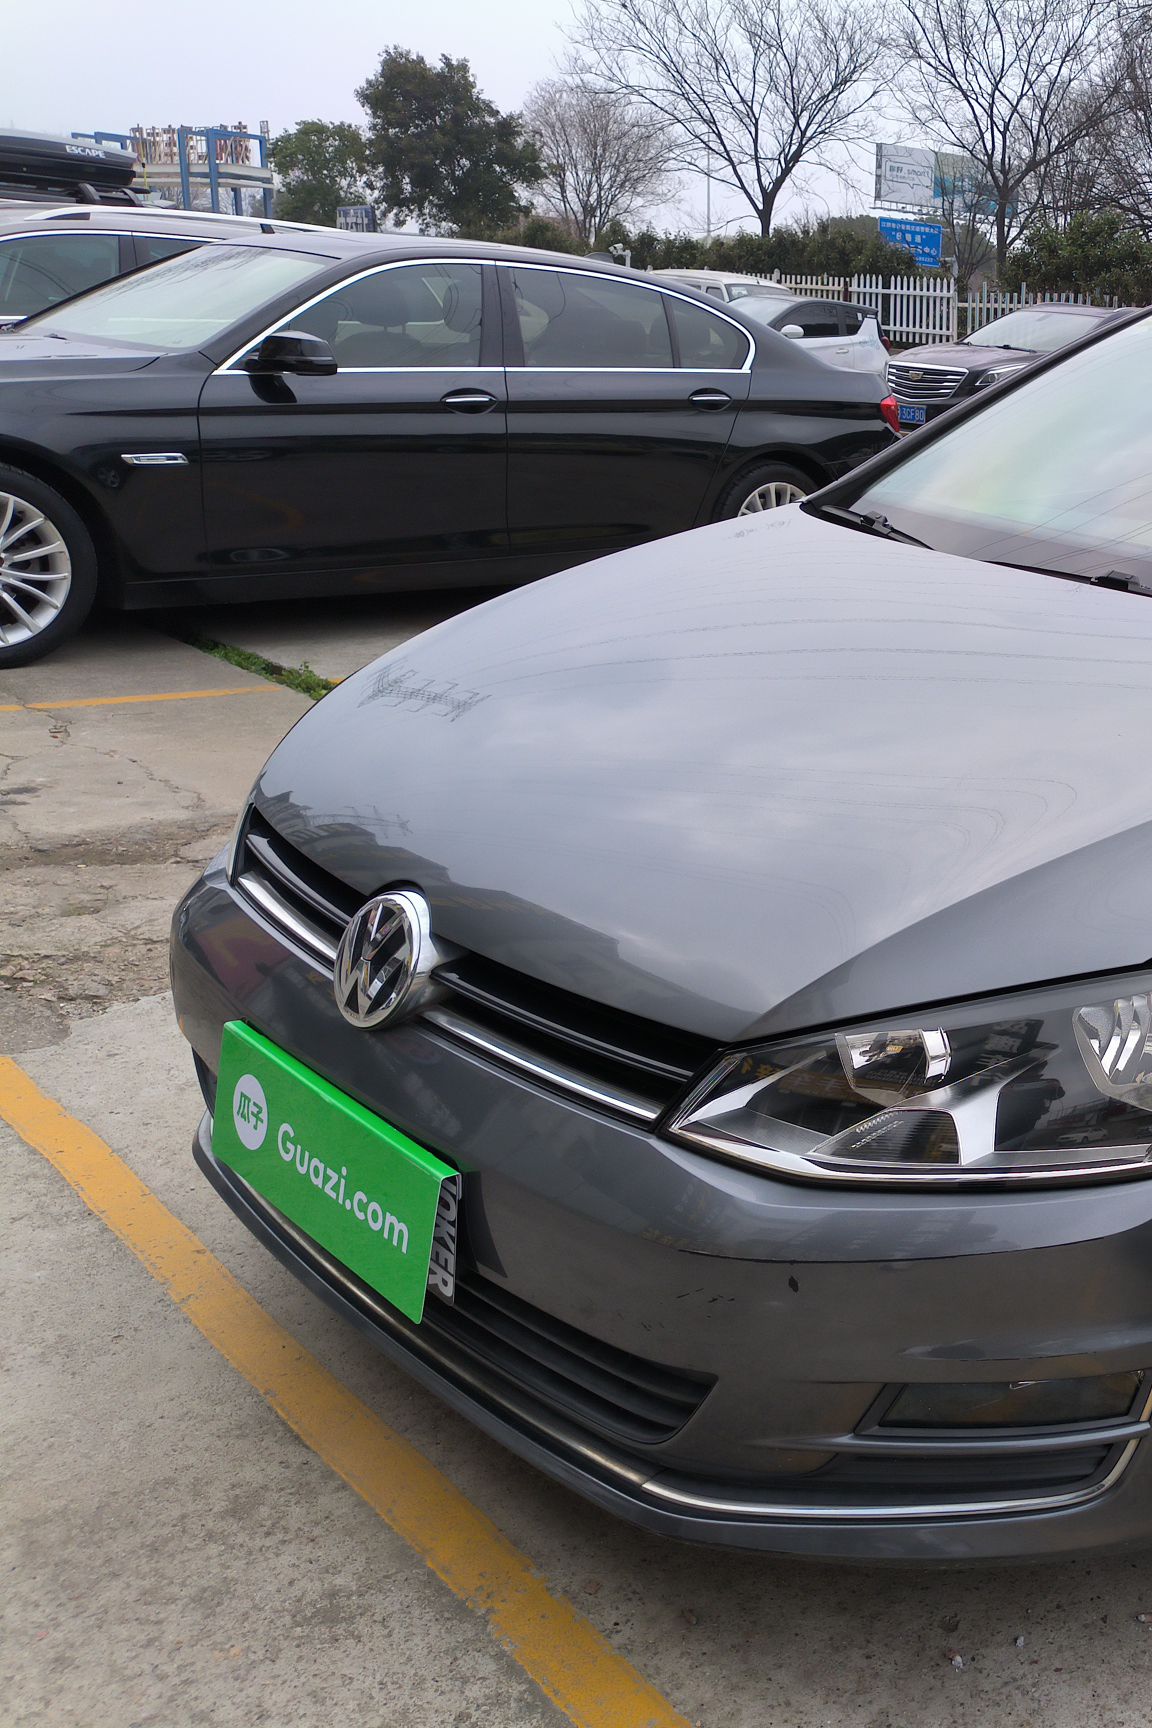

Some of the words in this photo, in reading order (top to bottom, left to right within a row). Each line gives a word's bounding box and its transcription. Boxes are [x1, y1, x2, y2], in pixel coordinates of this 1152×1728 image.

[65, 144, 106, 159] ESCAPE
[236, 1090, 264, 1131] 瓜子
[277, 1122, 409, 1255] Guazi.com
